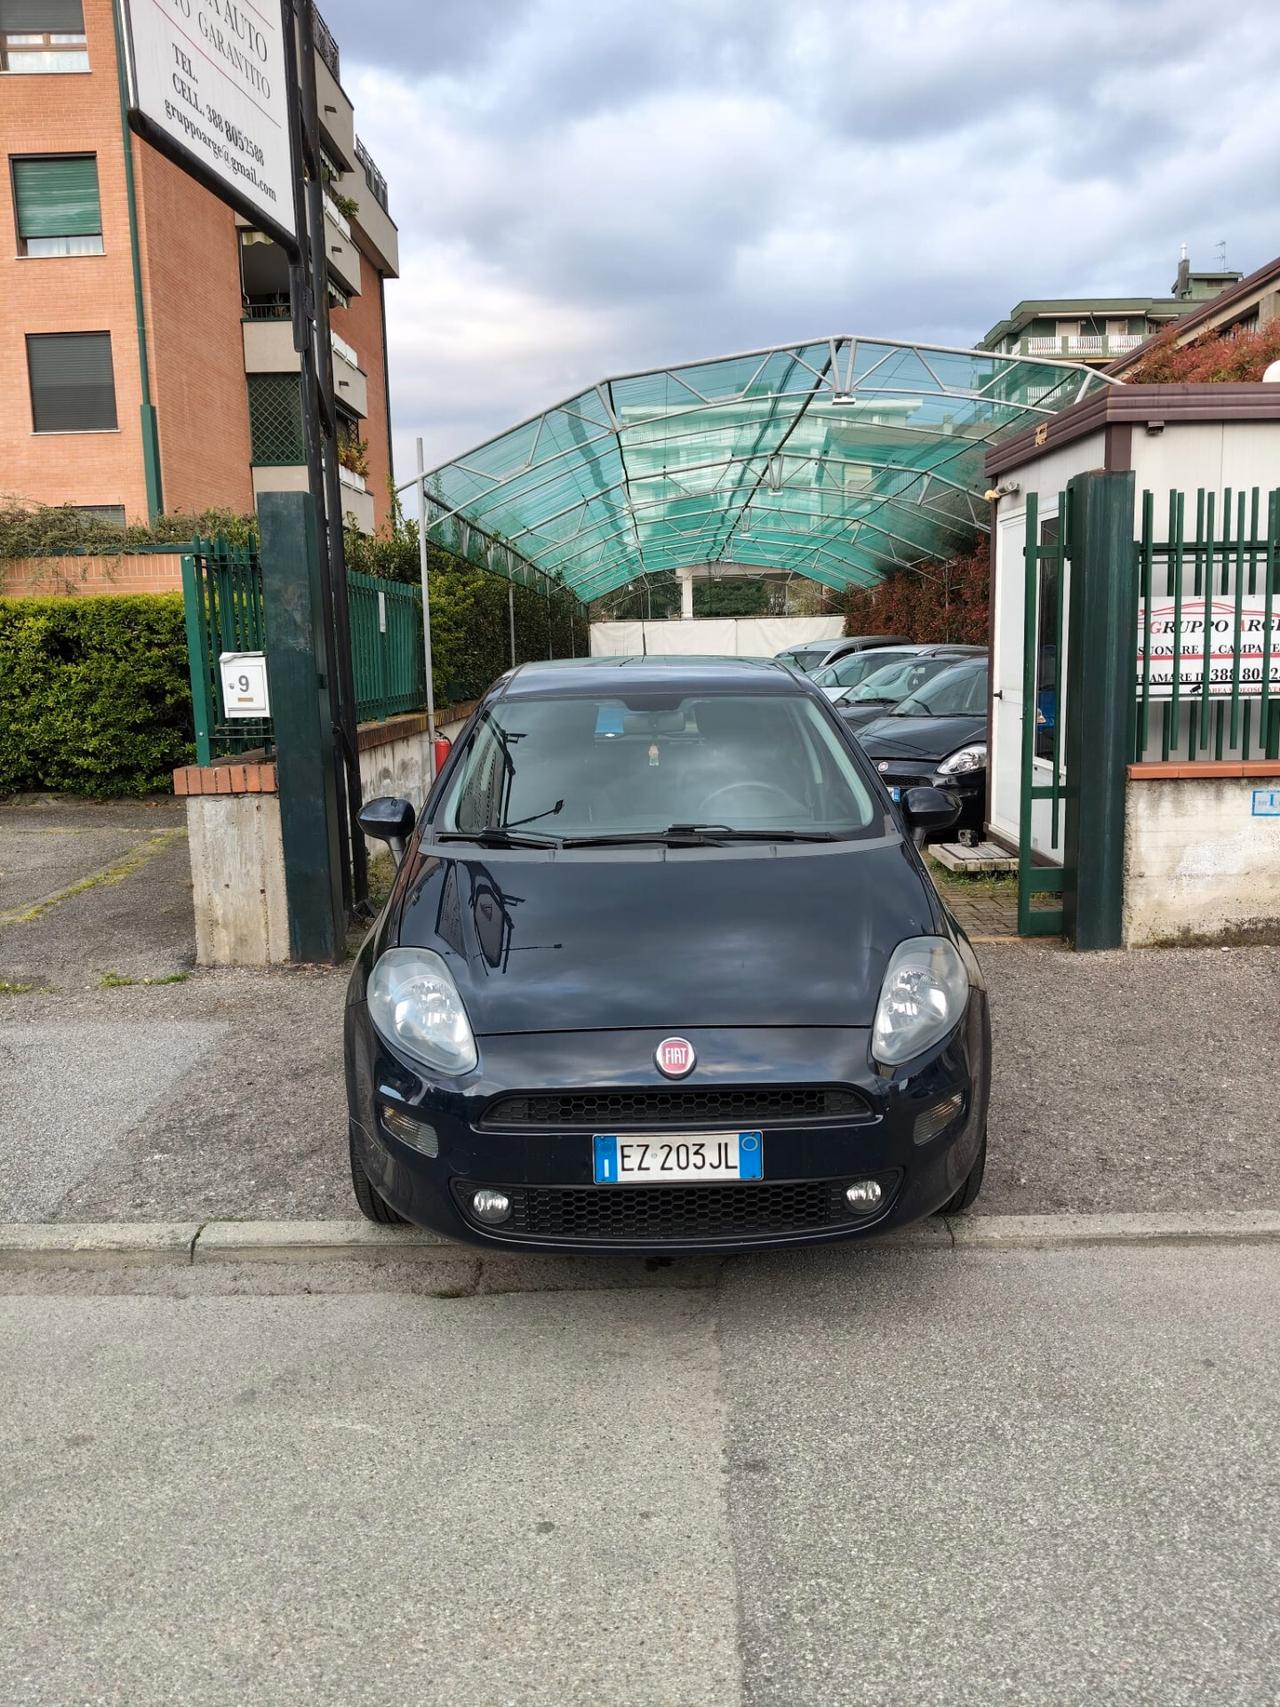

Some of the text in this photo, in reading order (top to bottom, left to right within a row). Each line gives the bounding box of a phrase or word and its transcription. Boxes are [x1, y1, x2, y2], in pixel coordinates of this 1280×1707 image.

[199, 12, 270, 99] GARANTITO
[224, 0, 267, 62] AUTO
[172, 43, 198, 84] TEL.
[173, 73, 205, 117] CELL.
[206, 104, 224, 133] 388
[238, 675, 250, 693] 9
[665, 1047, 687, 1065] FIAT
